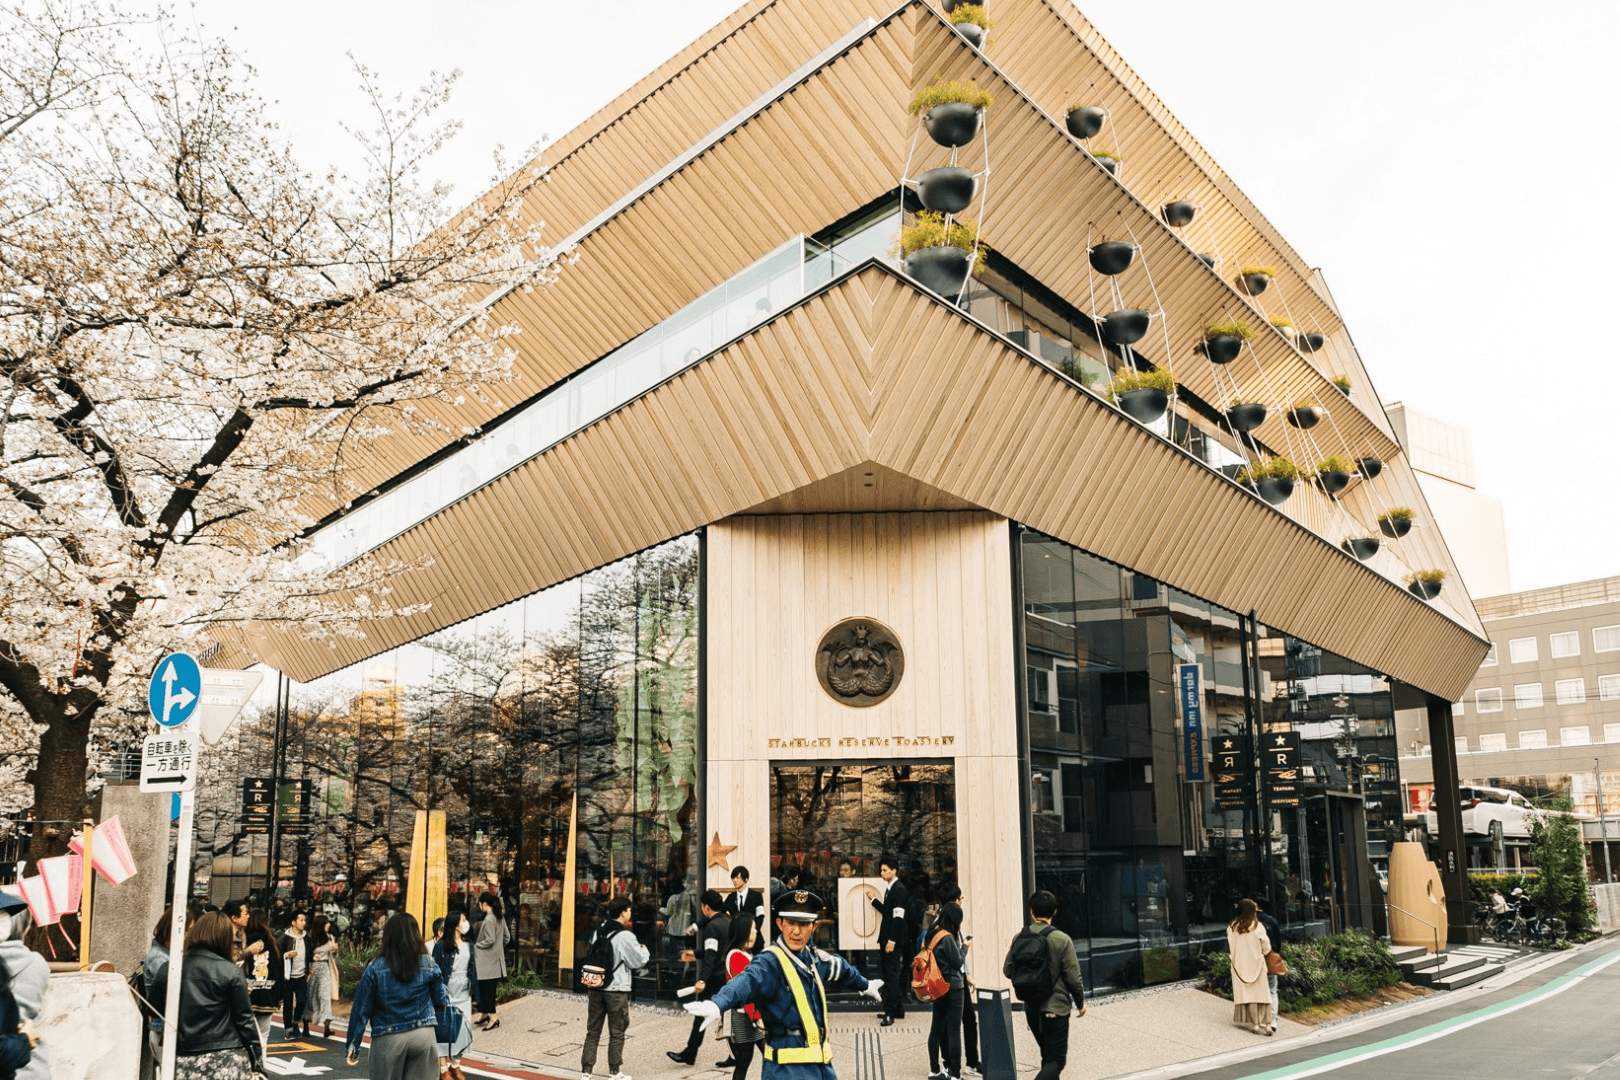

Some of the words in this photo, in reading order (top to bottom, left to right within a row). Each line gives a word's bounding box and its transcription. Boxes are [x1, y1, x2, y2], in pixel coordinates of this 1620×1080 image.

[147, 740, 192, 755] 自転車を除く
[768, 738, 832, 748] STARBUCKS
[838, 737, 890, 747] RESERVE
[896, 736, 955, 746] ROASTERY
[146, 756, 191, 771] 一方通行
[1276, 754, 1287, 765] R
[254, 794, 263, 802] R
